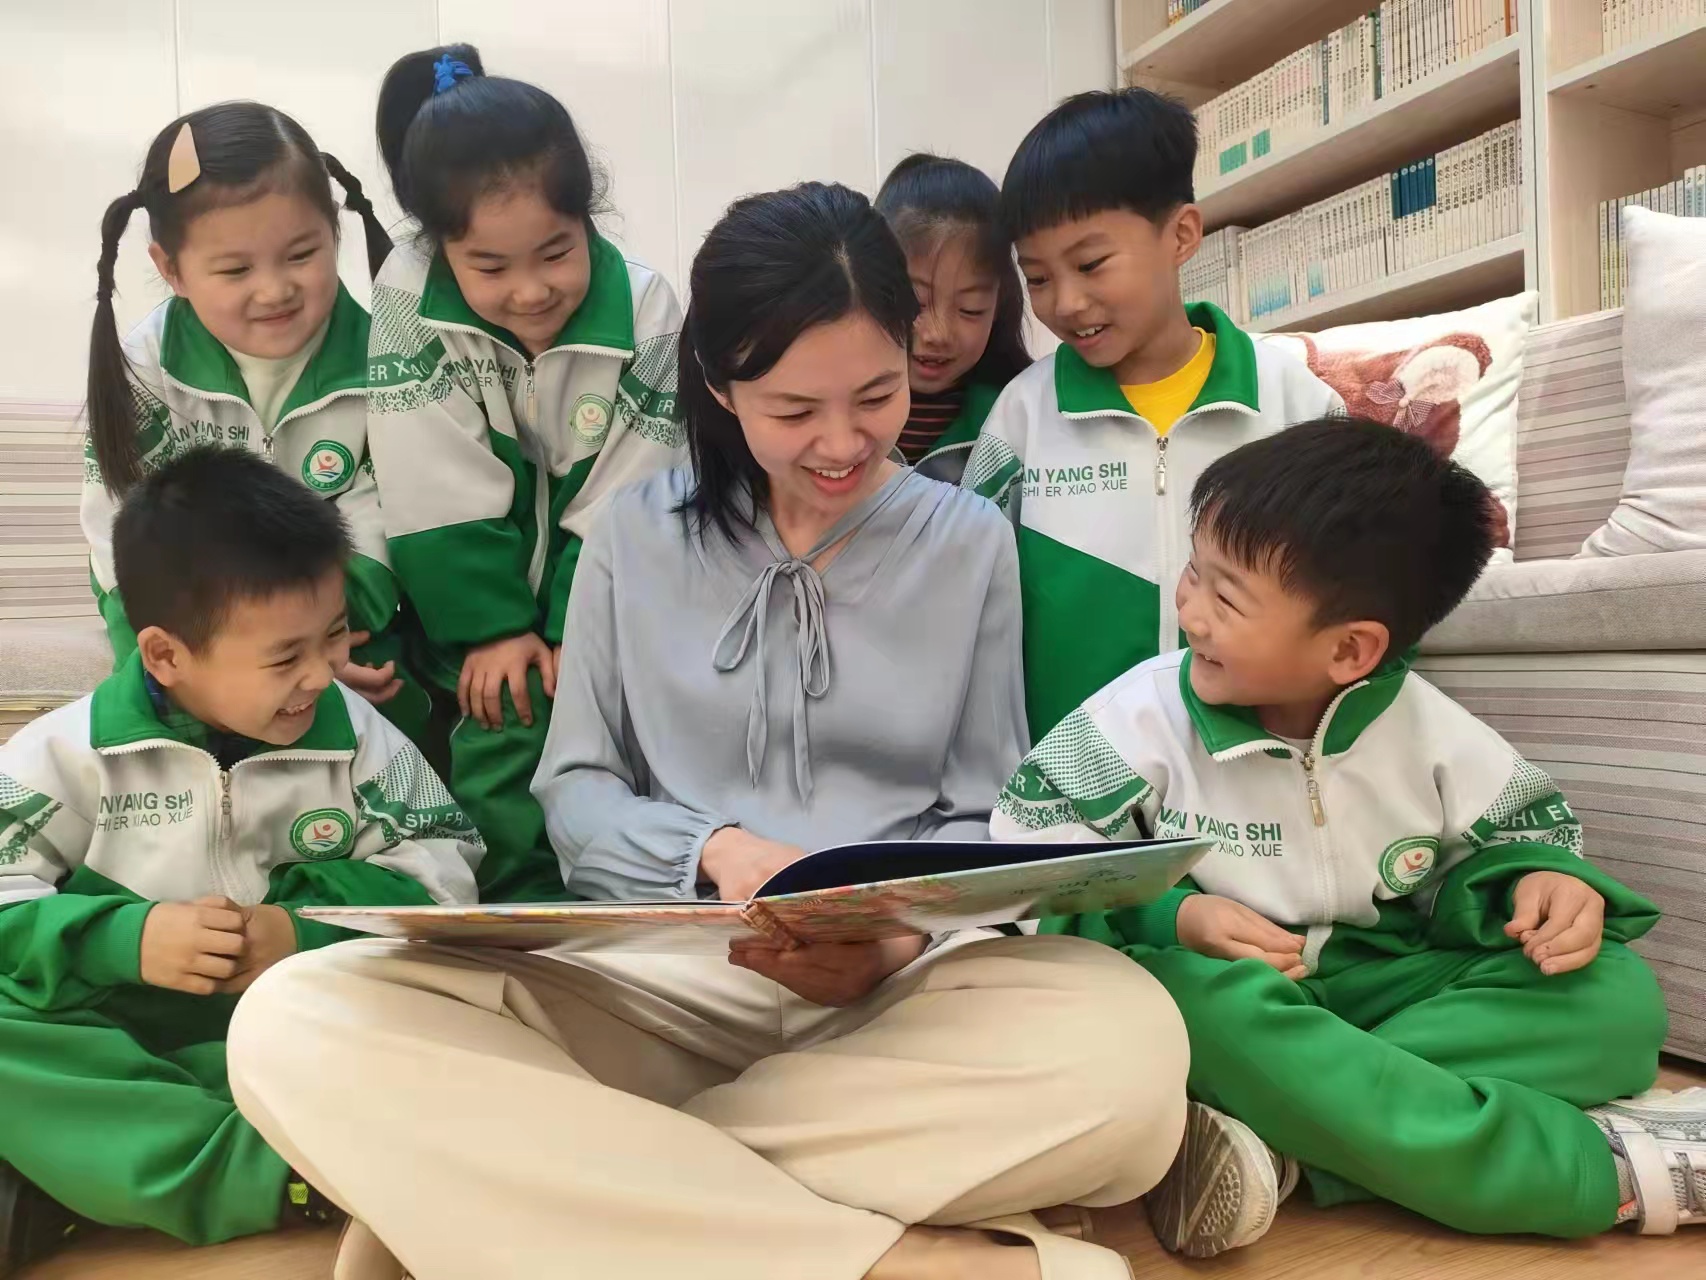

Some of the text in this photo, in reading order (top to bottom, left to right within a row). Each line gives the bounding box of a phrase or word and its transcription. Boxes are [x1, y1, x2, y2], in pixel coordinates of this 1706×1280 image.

[369, 365, 388, 380] ER
[501, 364, 517, 380] HI
[656, 400, 676, 415] ER
[228, 425, 250, 441] SHI
[1045, 465, 1093, 483] YANG
[1098, 461, 1128, 478] SHI
[1022, 479, 1128, 498] SHI ER XIAO XUE
[165, 788, 194, 810] SHI
[96, 818, 112, 832] HI
[167, 806, 193, 825] XUE
[1194, 813, 1239, 840] YANG
[1245, 822, 1282, 841] SHI
[1218, 840, 1283, 857] XIAO XUE
